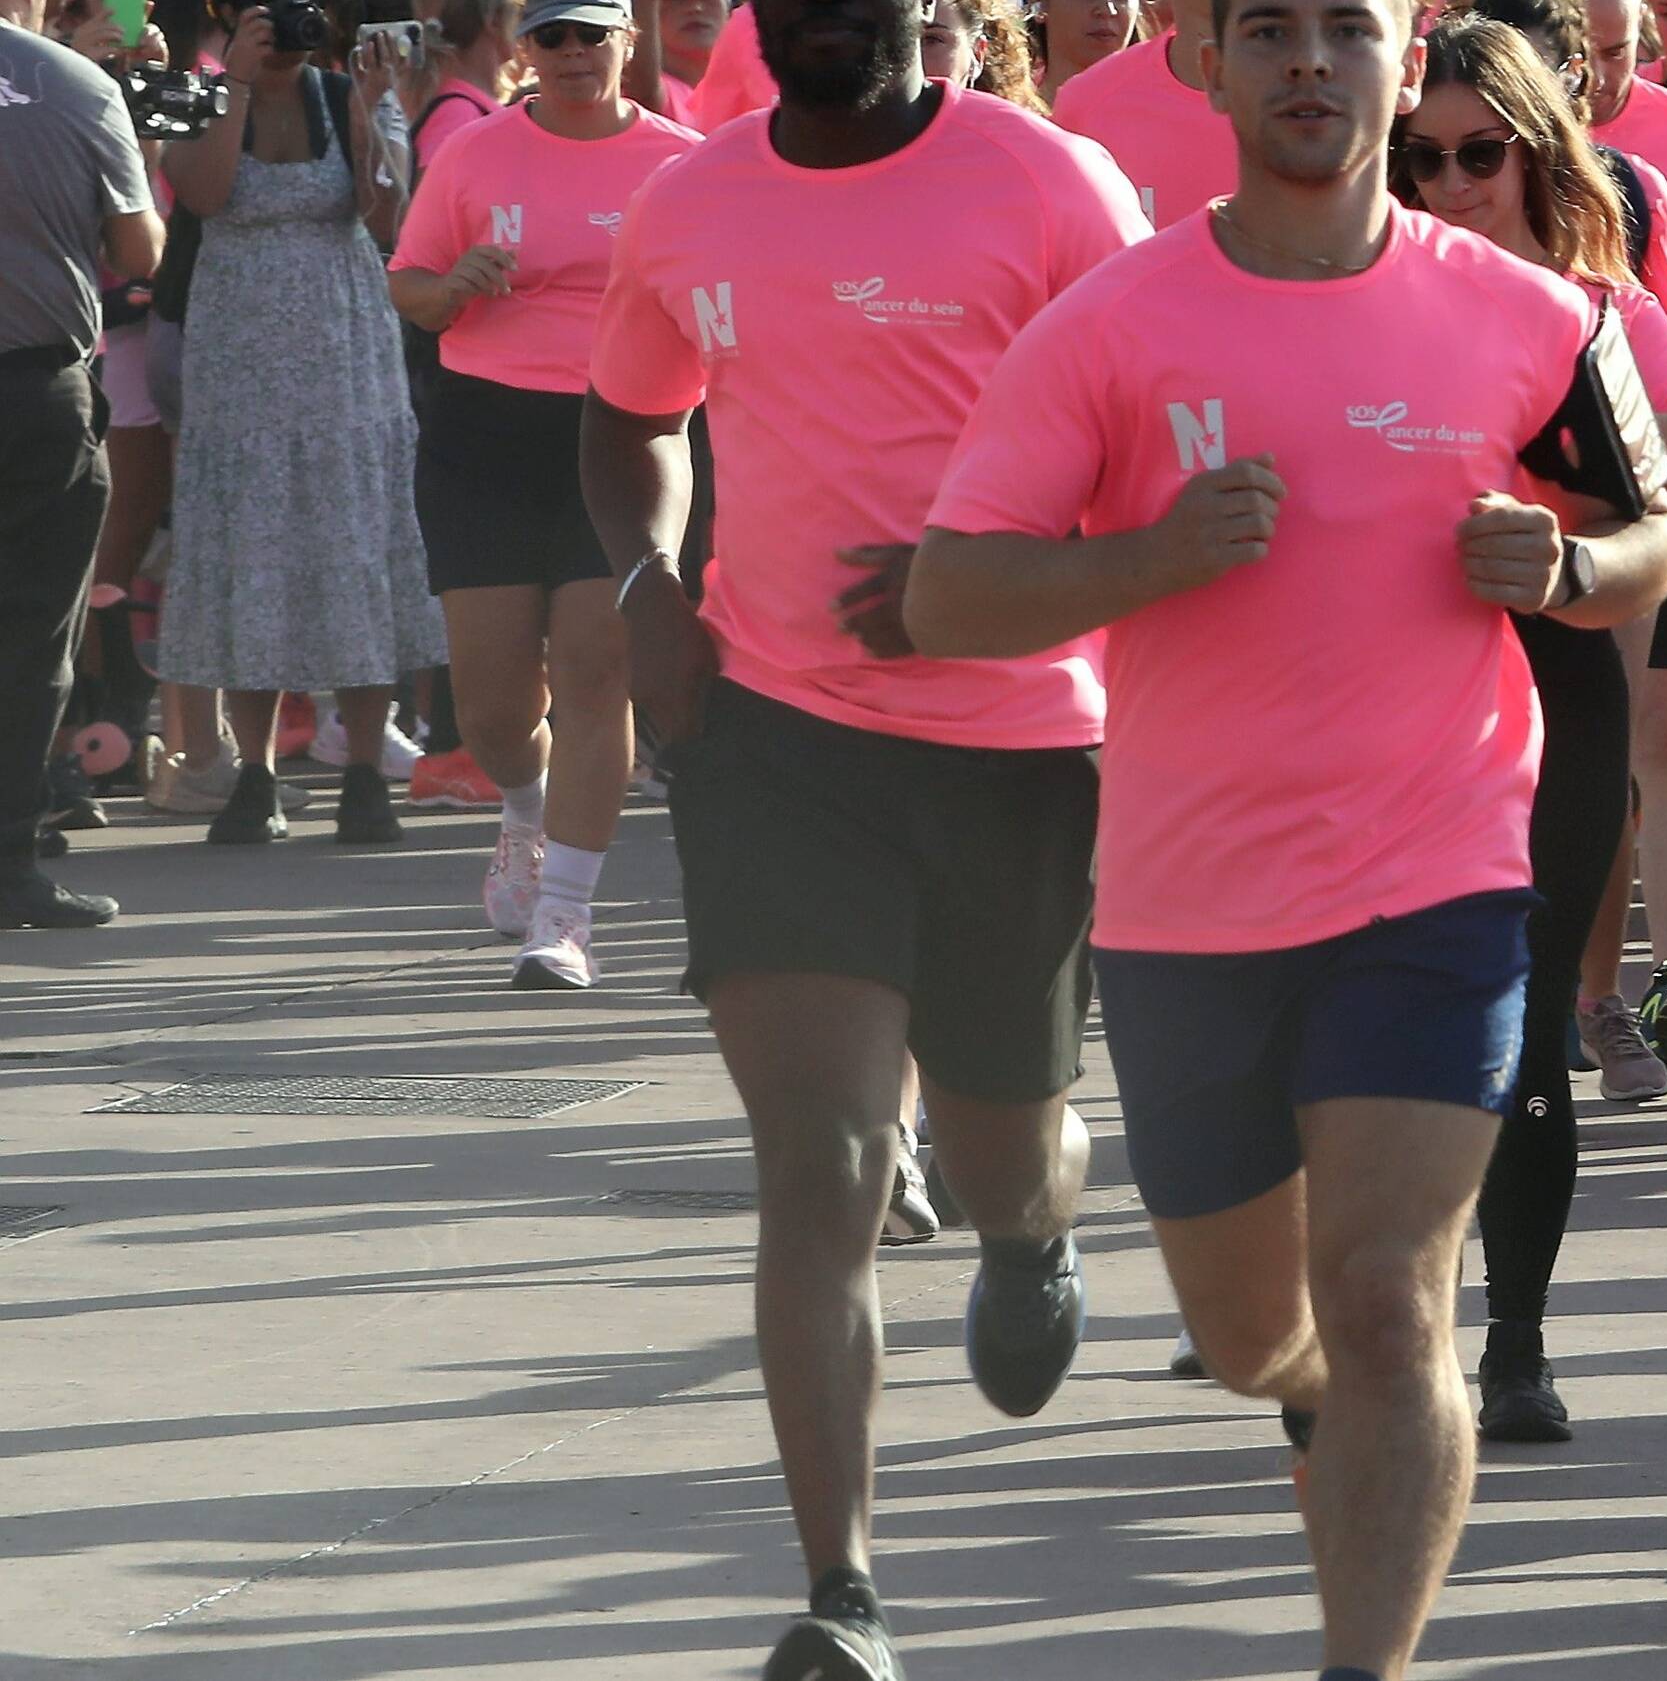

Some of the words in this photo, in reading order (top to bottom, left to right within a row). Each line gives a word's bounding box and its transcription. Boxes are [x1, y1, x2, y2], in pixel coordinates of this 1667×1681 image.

[490, 204, 522, 244] N
[832, 281, 859, 295] SOS
[690, 281, 737, 352] N
[908, 298, 929, 315] du
[932, 300, 964, 316] sein
[1346, 404, 1378, 420] SOS
[1167, 398, 1226, 470] N
[1435, 425, 1455, 441] du
[1458, 428, 1485, 444] sein
